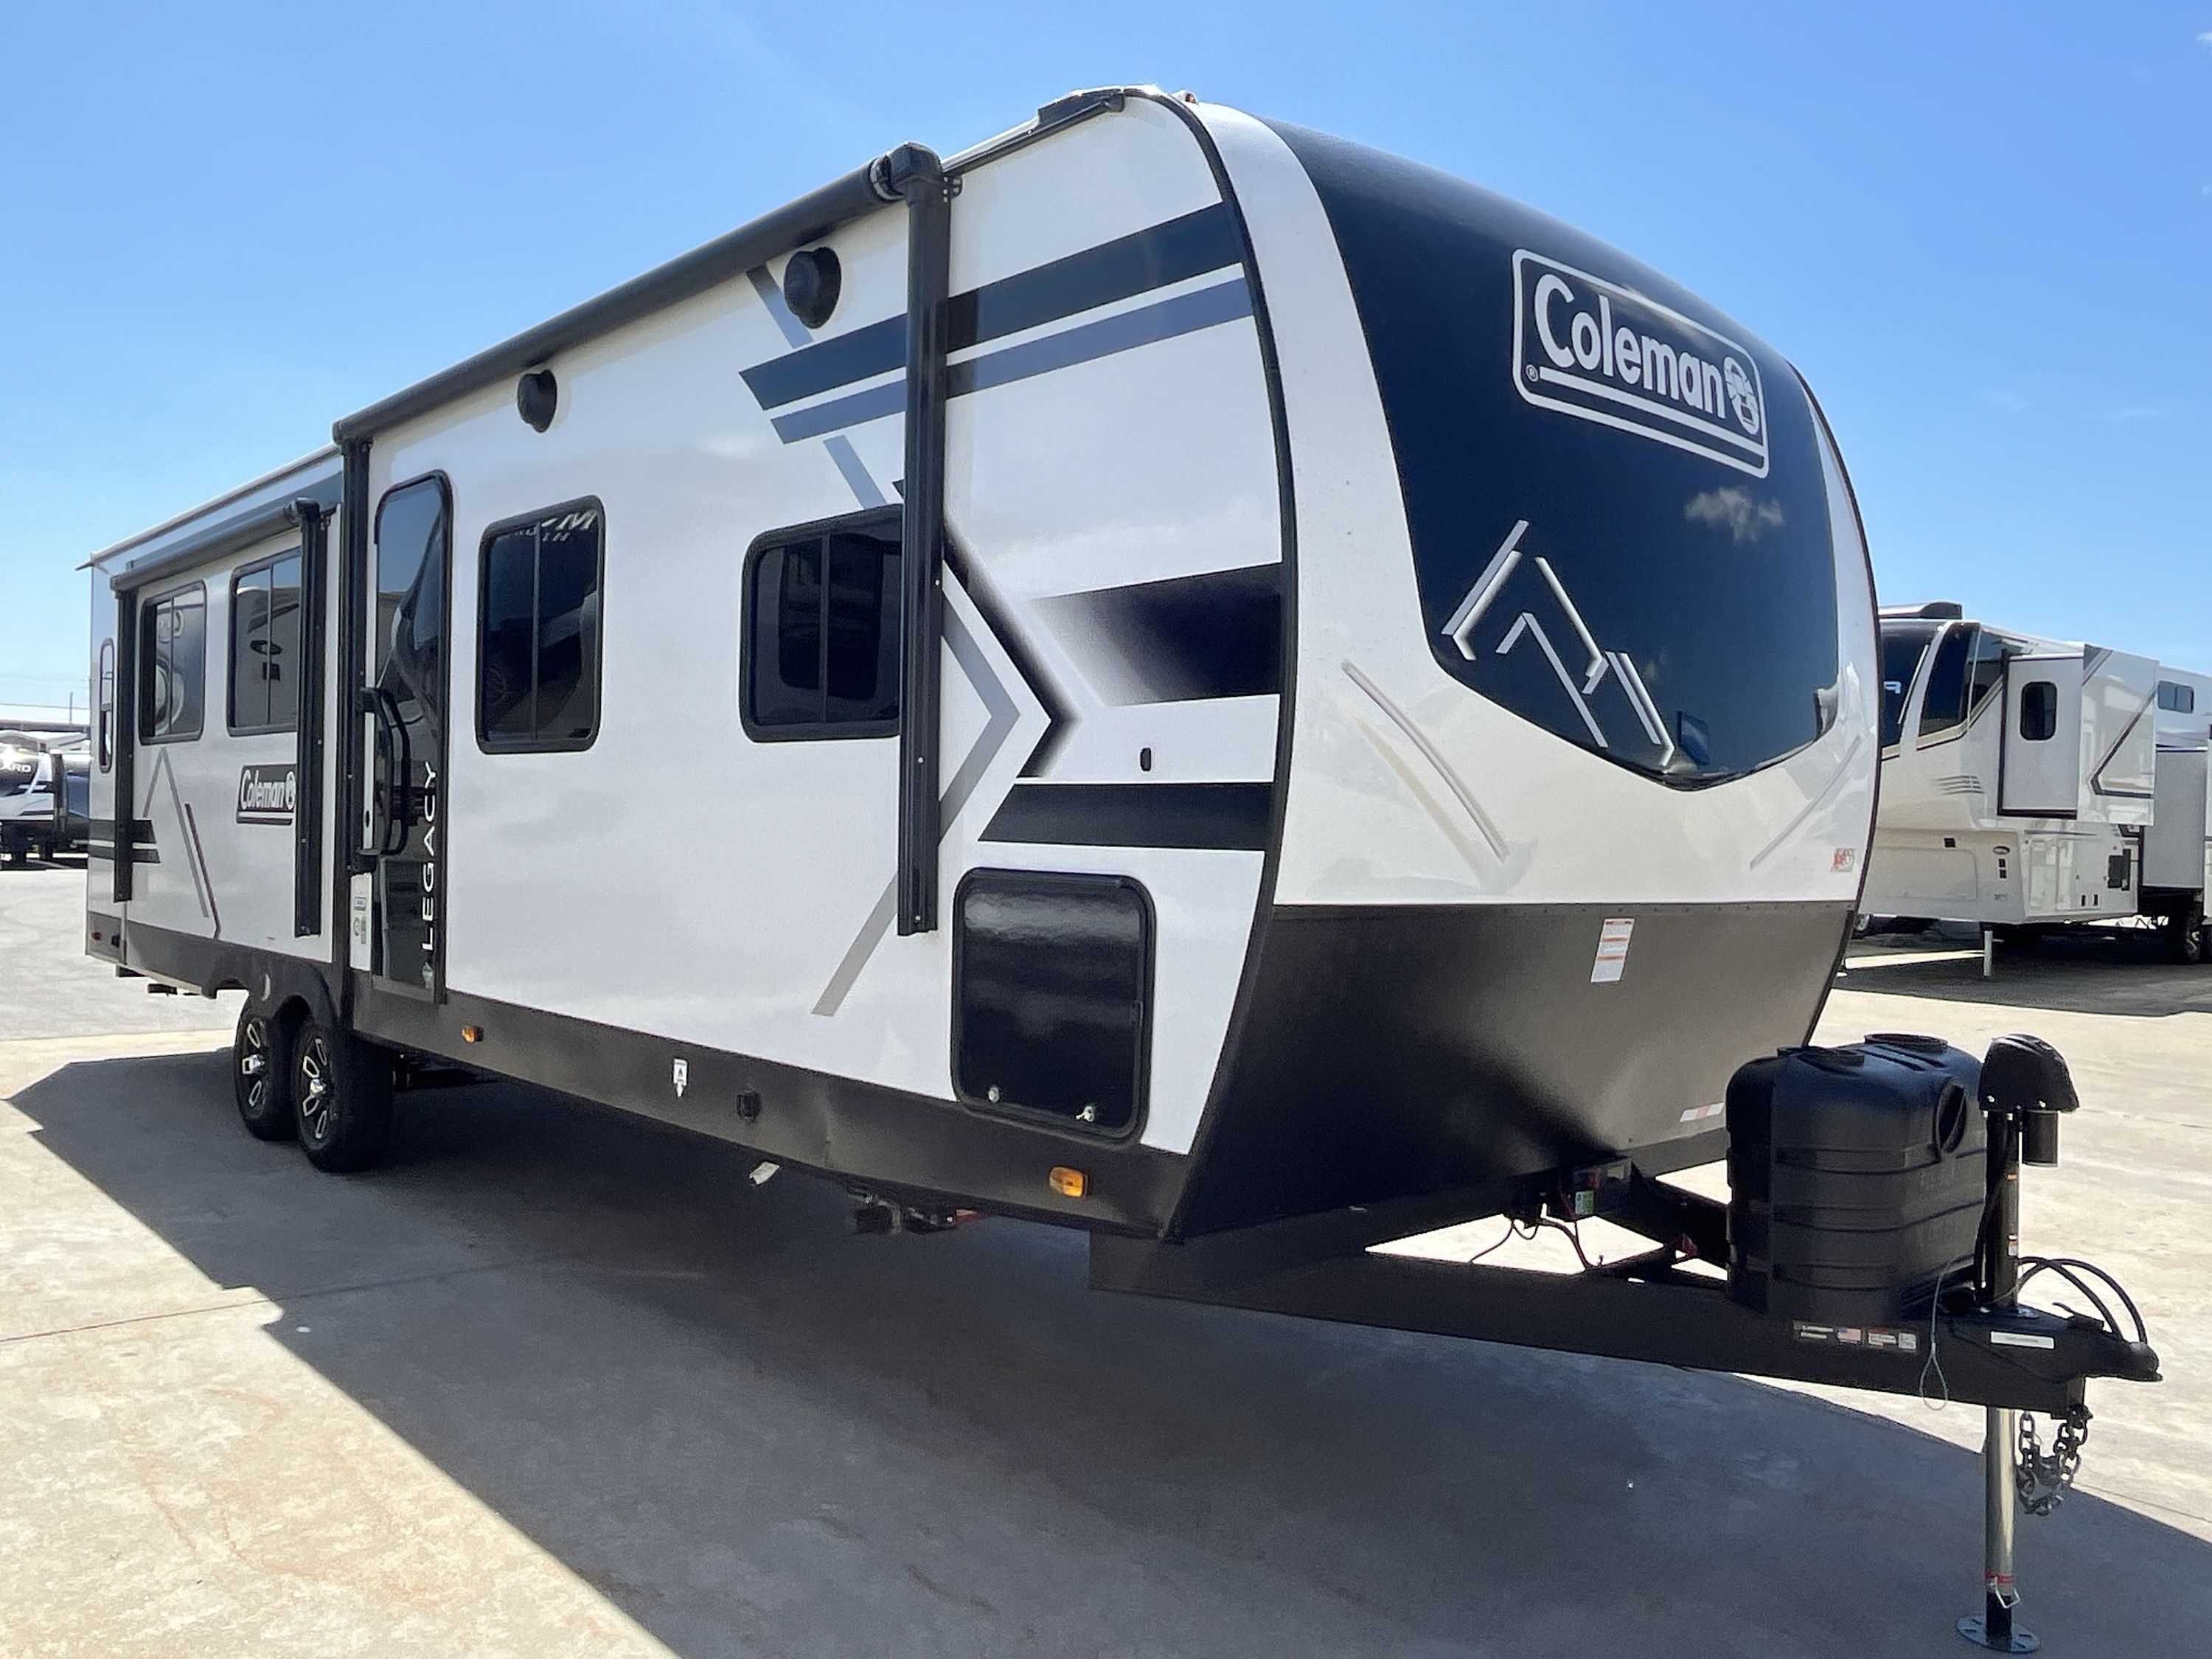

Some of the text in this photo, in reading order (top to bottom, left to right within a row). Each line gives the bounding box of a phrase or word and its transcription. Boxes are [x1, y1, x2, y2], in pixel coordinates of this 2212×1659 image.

[1534, 274, 1726, 419] Coleman
[240, 769, 285, 810] Coleman
[420, 760, 437, 951] LEGACY
